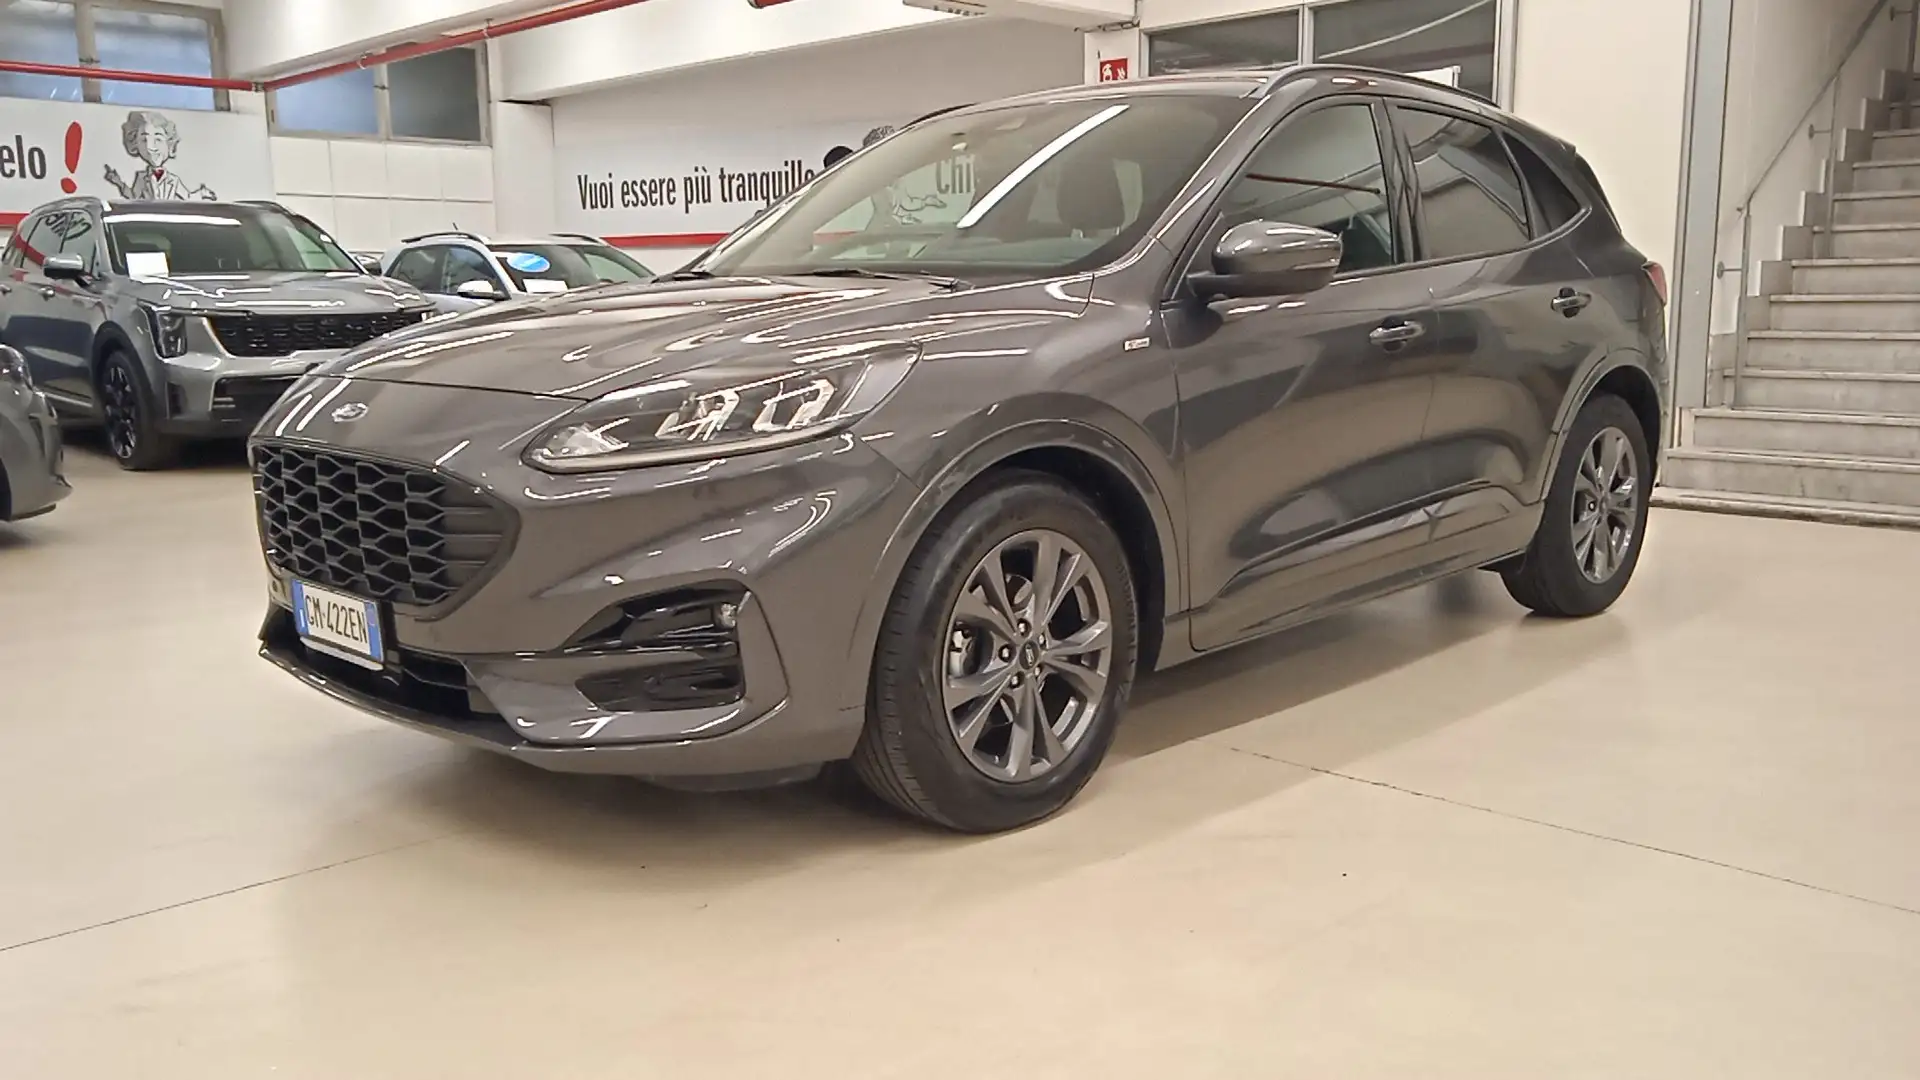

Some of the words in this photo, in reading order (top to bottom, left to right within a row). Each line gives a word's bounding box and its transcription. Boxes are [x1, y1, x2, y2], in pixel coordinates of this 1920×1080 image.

[577, 172, 614, 210] Vuoi
[621, 177, 676, 208] essere
[683, 165, 712, 214] più
